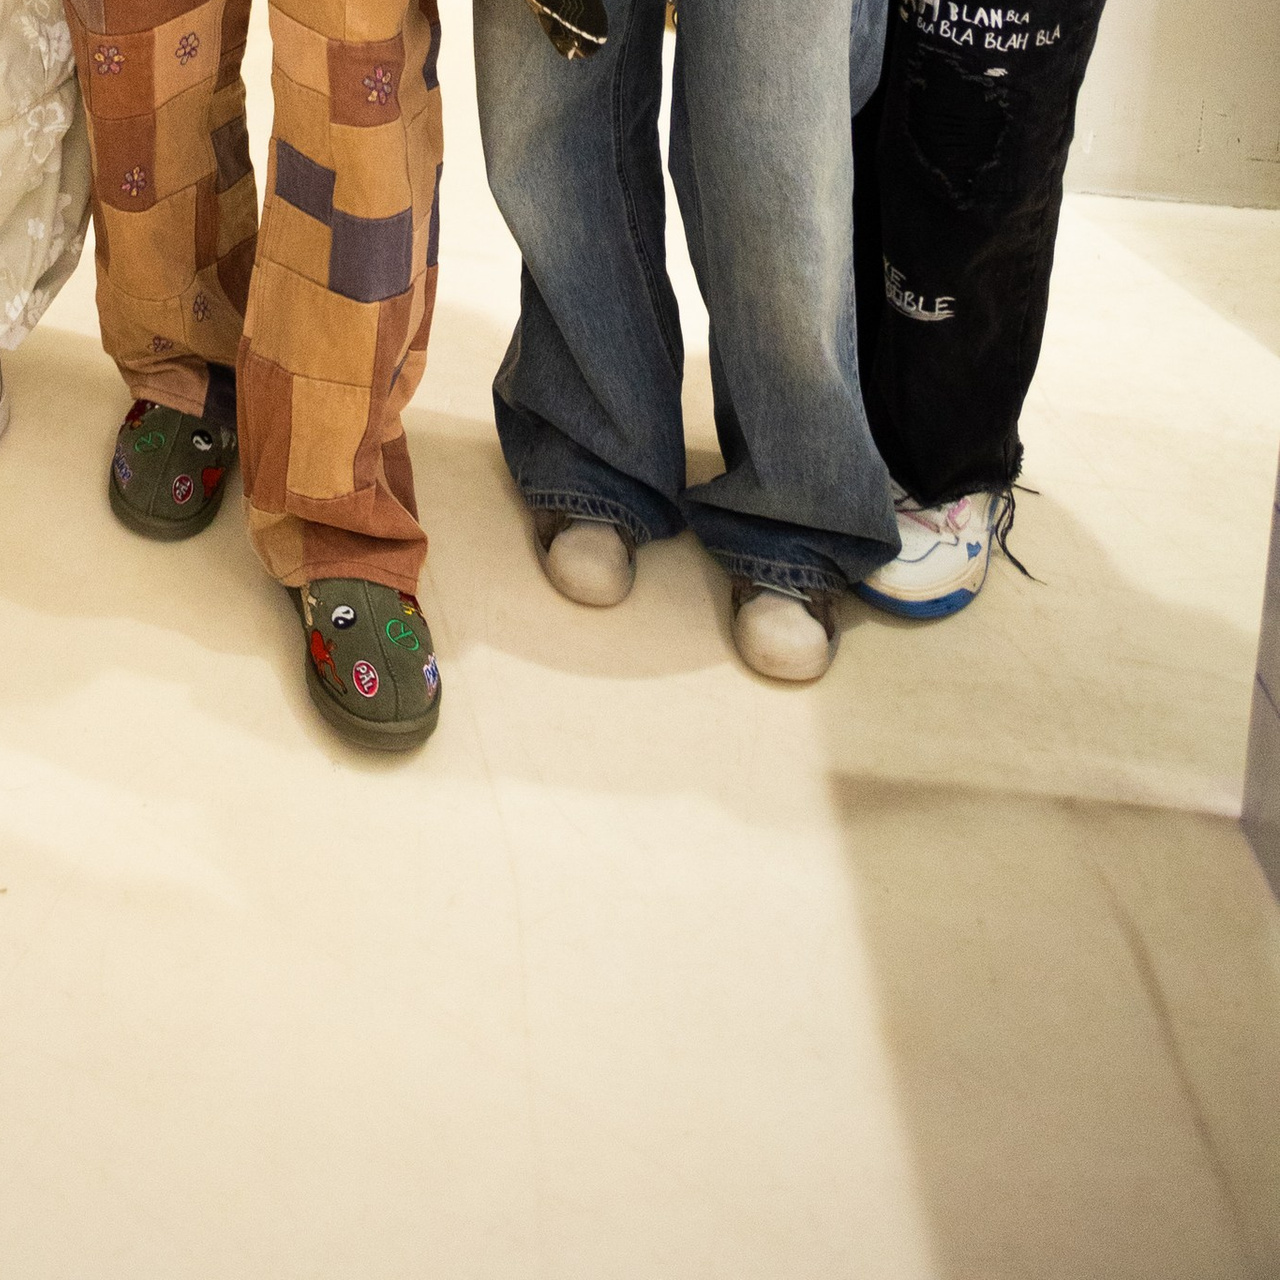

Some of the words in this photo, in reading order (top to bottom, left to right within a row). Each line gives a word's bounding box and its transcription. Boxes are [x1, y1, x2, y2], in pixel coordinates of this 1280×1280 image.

[939, 20, 973, 46] BLA
[984, 32, 1029, 52] BLAH
[1035, 24, 1061, 46] BLA
